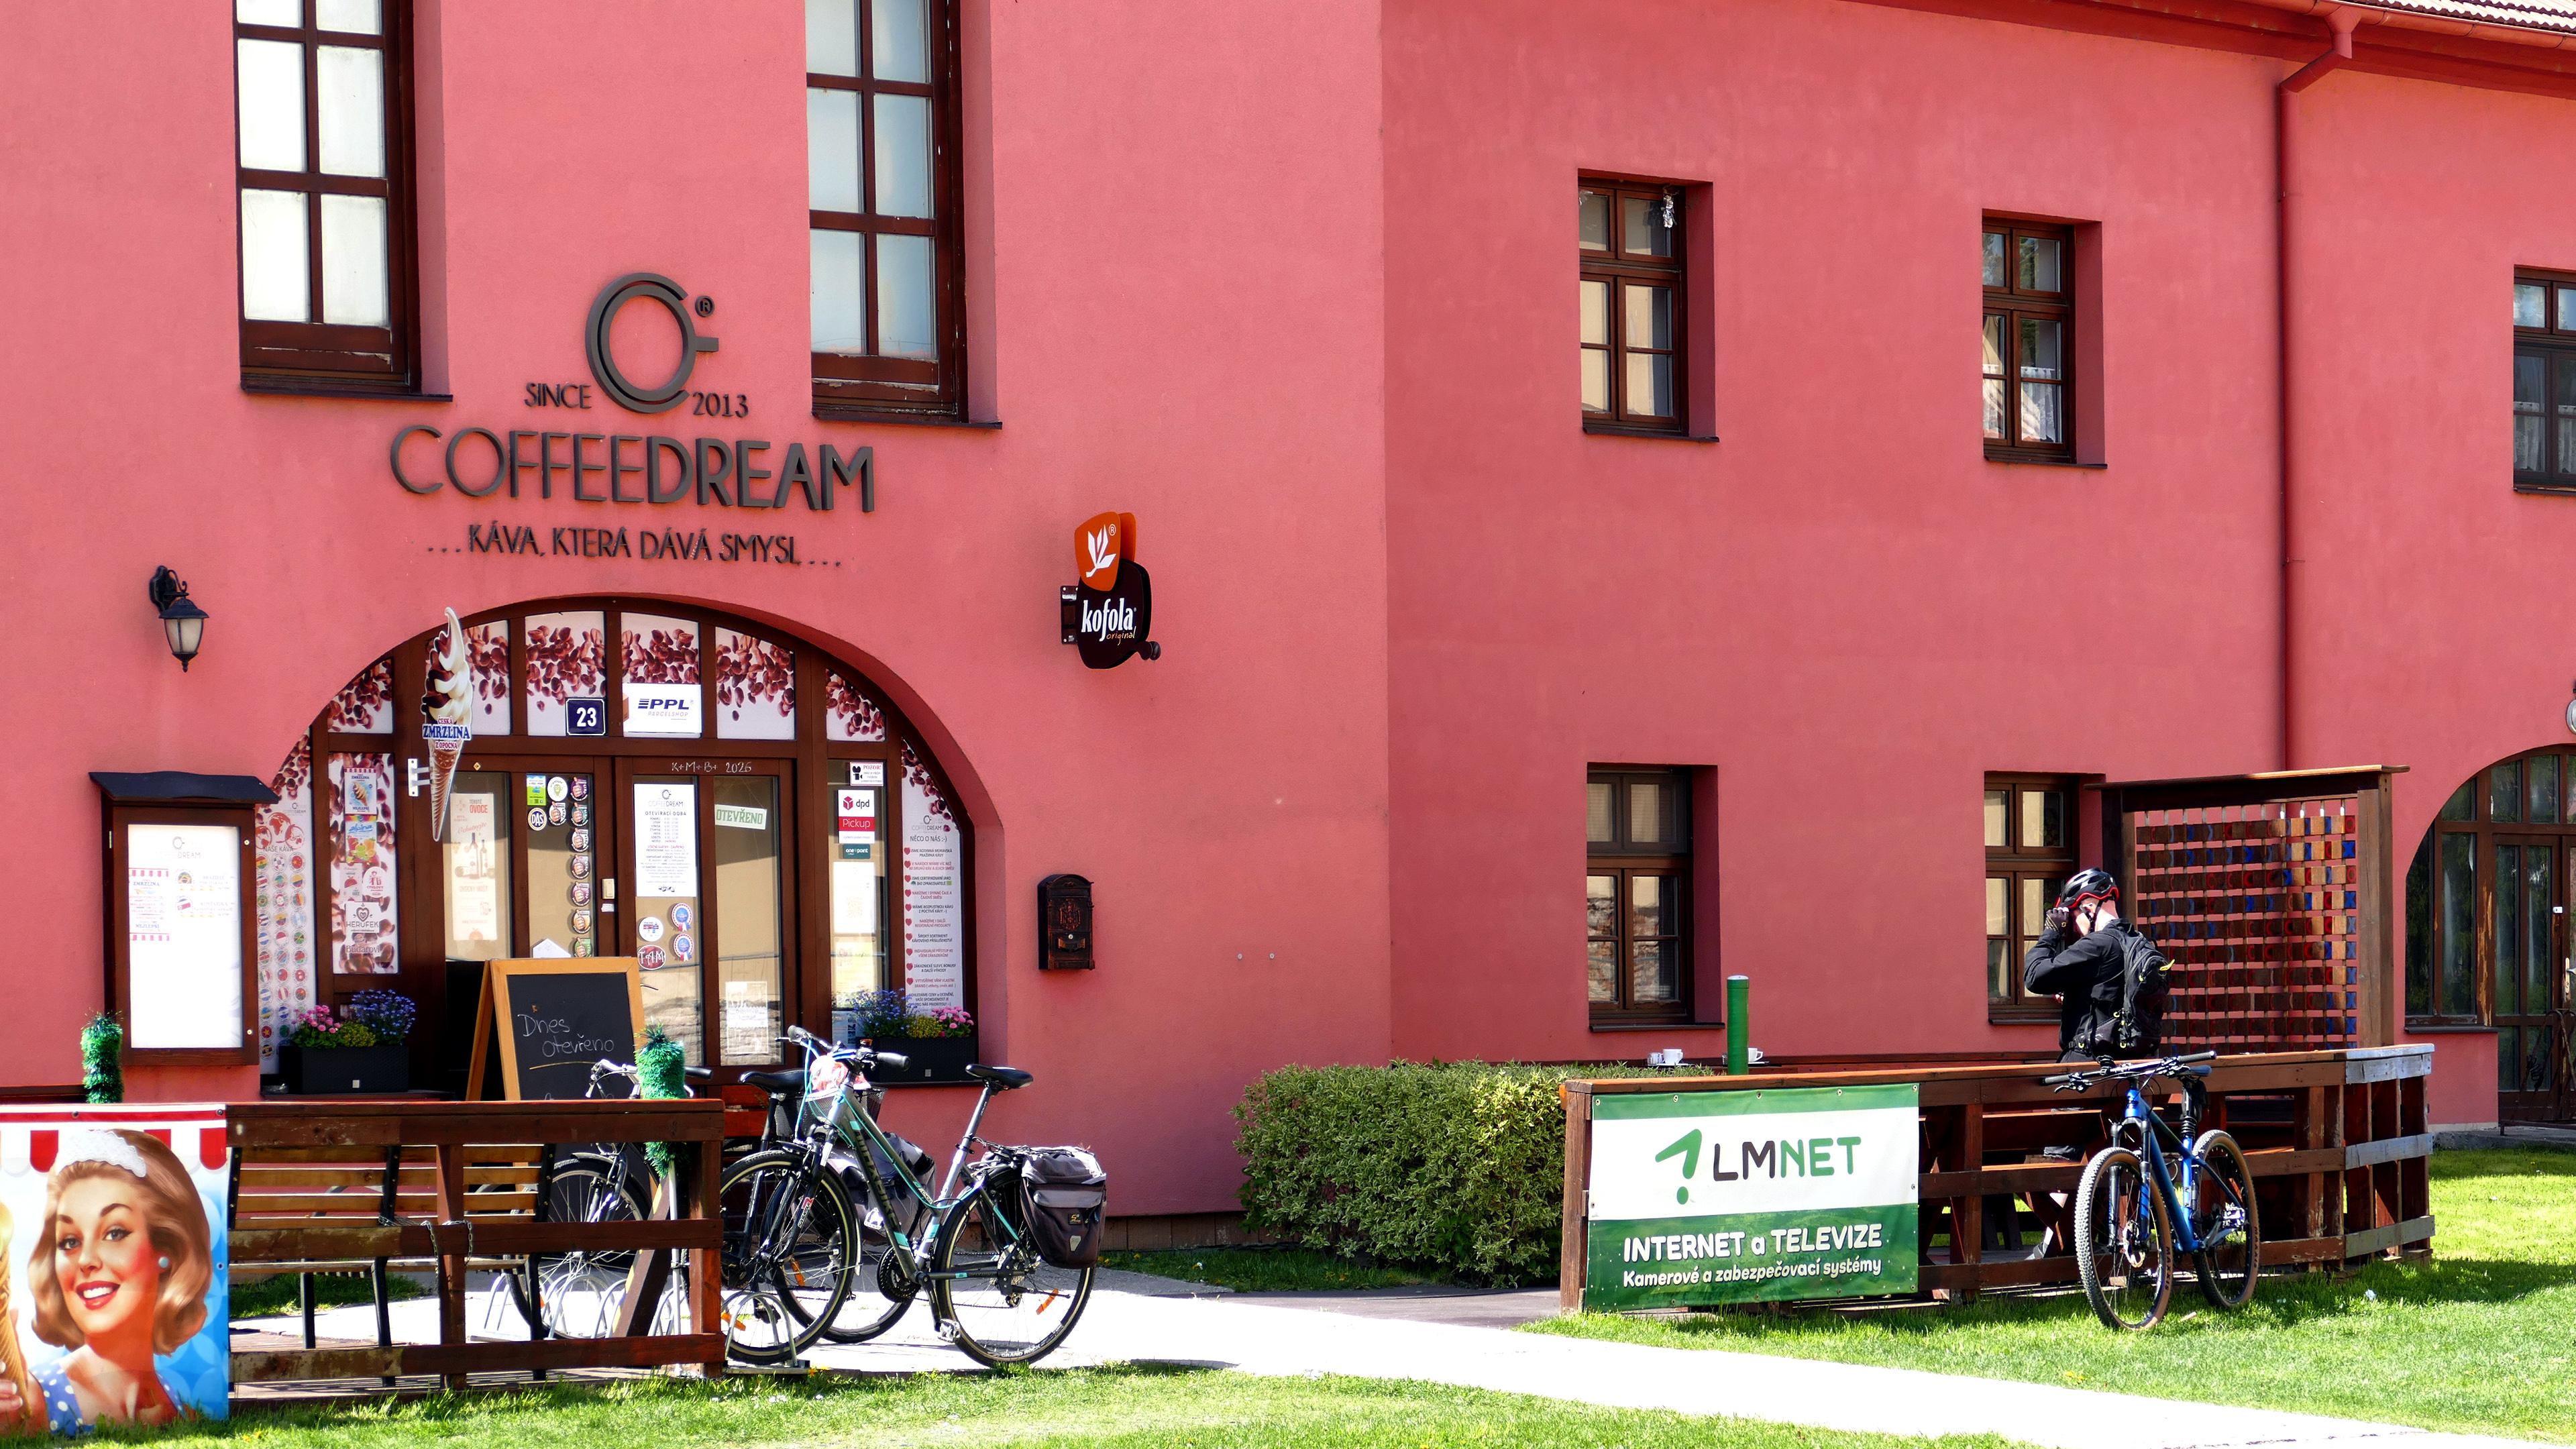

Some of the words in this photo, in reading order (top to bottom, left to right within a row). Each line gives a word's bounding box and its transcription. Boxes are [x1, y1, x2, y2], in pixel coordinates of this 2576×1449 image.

[524, 382, 592, 409] SINCE
[692, 391, 749, 417] 2013
[390, 425, 875, 512] COFFEEDREAM
[552, 526, 632, 557] KTERÁ
[641, 527, 712, 561] DÁVÁ
[1081, 598, 1134, 641] kofola
[1106, 626, 1136, 645] original
[649, 699, 690, 710] PPL
[576, 706, 597, 727] 23
[423, 725, 470, 739] ZMRZLINA
[726, 761, 752, 773] 2026
[470, 804, 488, 814] OVOCE
[856, 799, 870, 809] dpd
[716, 808, 763, 825] OTEVŘENO
[843, 818, 871, 828] Pickup
[517, 1013, 571, 1037] Dnes
[542, 1033, 614, 1058] otevřeno
[1713, 1136, 1862, 1181] LMNET
[1623, 1232, 1746, 1263] INTERNET
[1751, 1237, 1766, 1256] a
[1771, 1224, 1883, 1253] TELEVIZE
[1623, 1265, 1699, 1288] Kamerové
[1703, 1271, 1713, 1283] a
[1715, 1258, 1821, 1284] zabezpečovací
[1823, 1257, 1882, 1279] systémy
